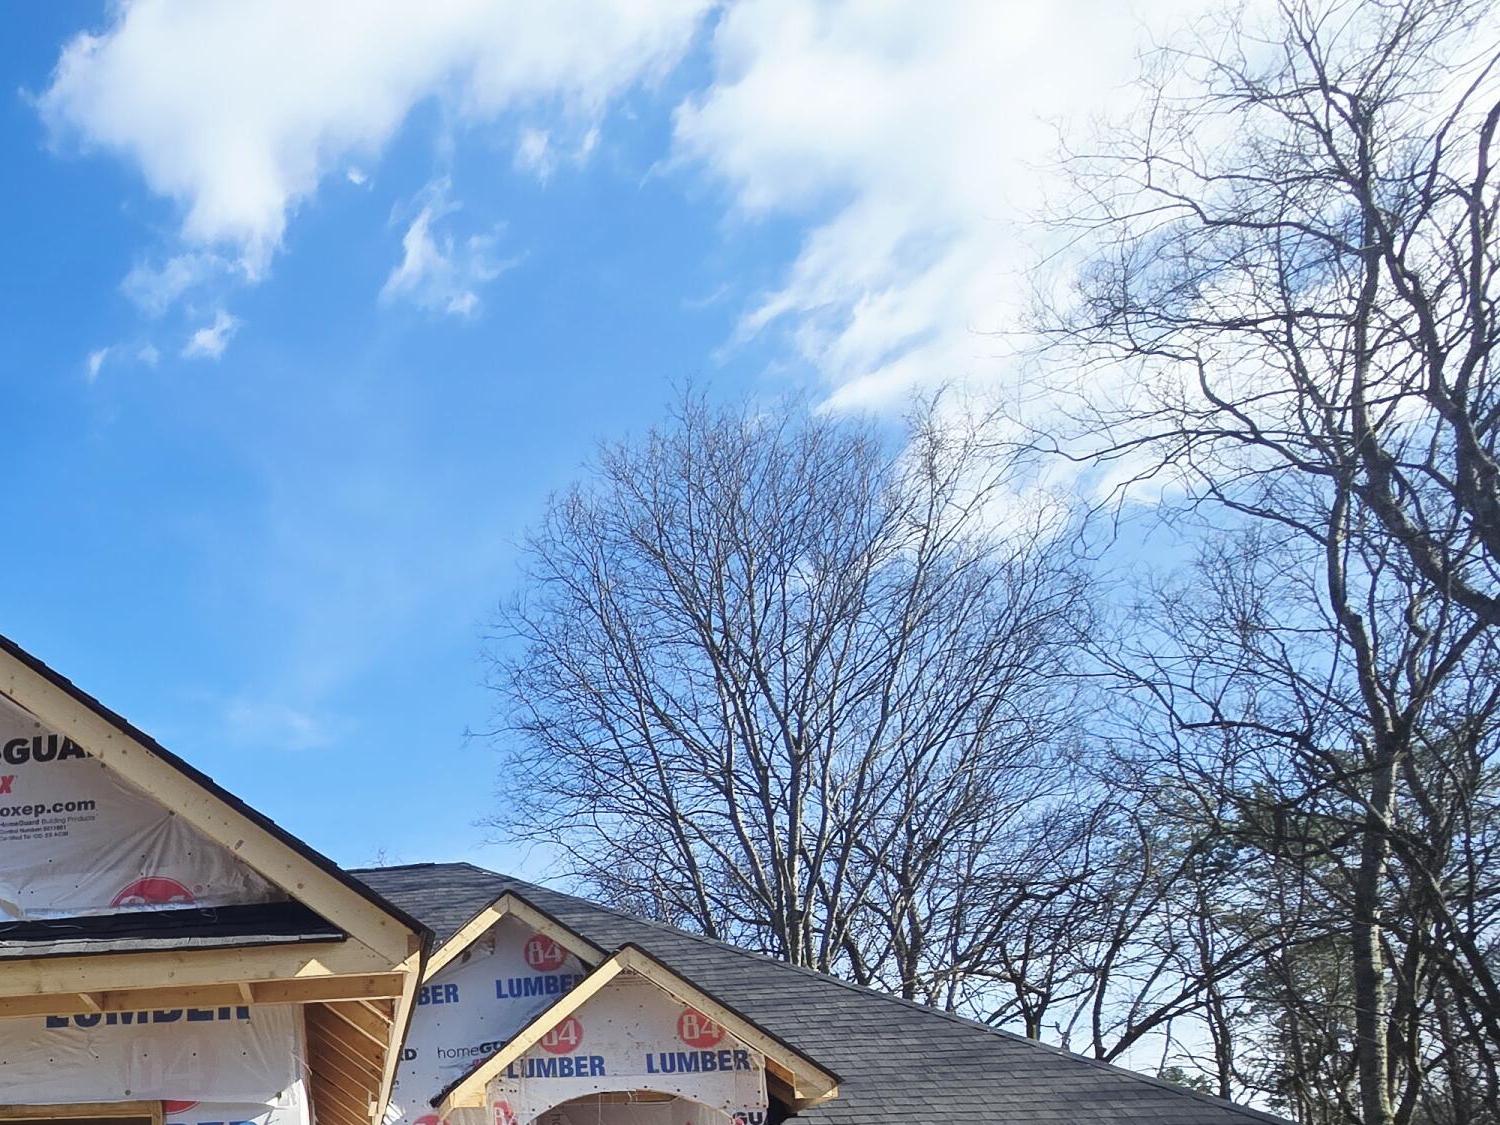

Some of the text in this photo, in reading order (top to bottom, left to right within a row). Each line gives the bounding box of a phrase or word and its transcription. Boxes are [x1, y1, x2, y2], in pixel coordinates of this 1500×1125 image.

[0, 800, 96, 818] oxep.com
[529, 941, 564, 964] 84
[418, 983, 459, 1006] BER
[507, 1056, 606, 1079] LUMBER
[646, 1049, 750, 1073] LUMBER
